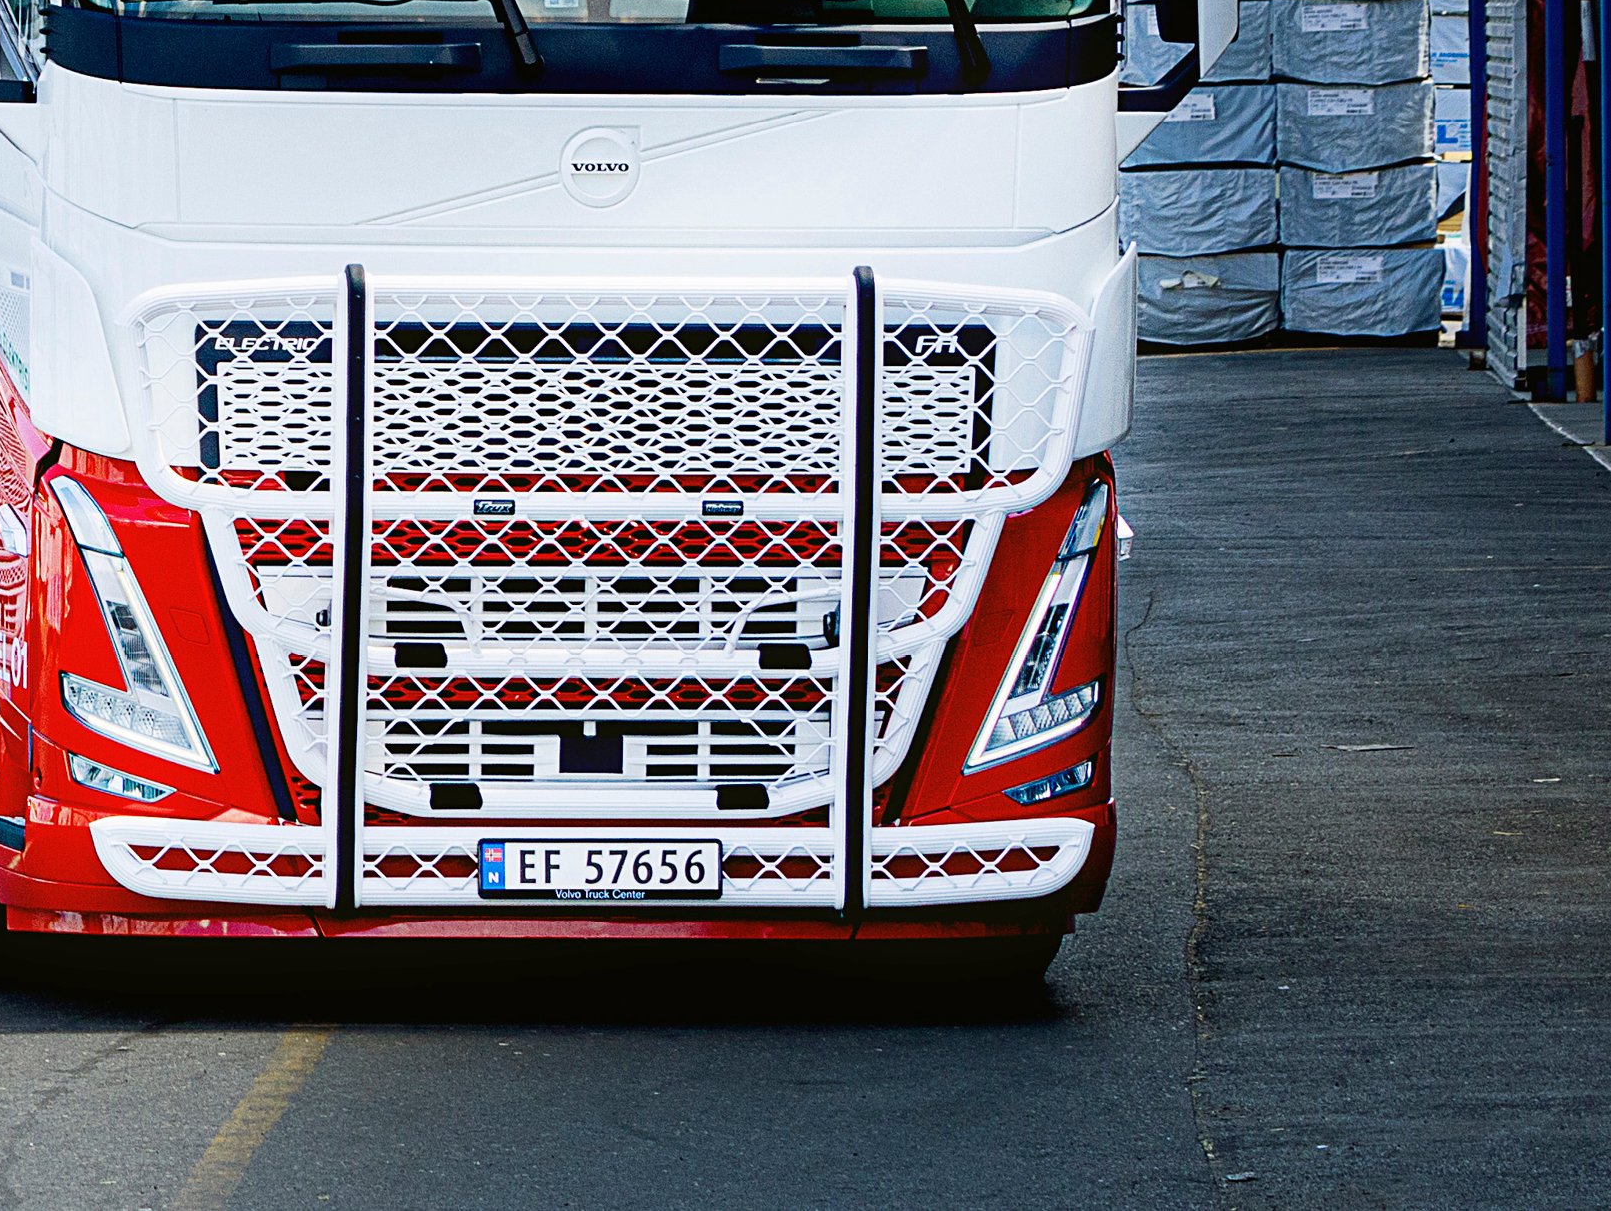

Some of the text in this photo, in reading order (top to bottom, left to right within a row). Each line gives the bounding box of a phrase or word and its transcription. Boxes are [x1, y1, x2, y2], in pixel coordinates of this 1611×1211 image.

[571, 163, 629, 172] VOLVO
[519, 849, 706, 884] EF 57656
[488, 871, 499, 883] N
[555, 889, 646, 899] Volvo Truck Center
